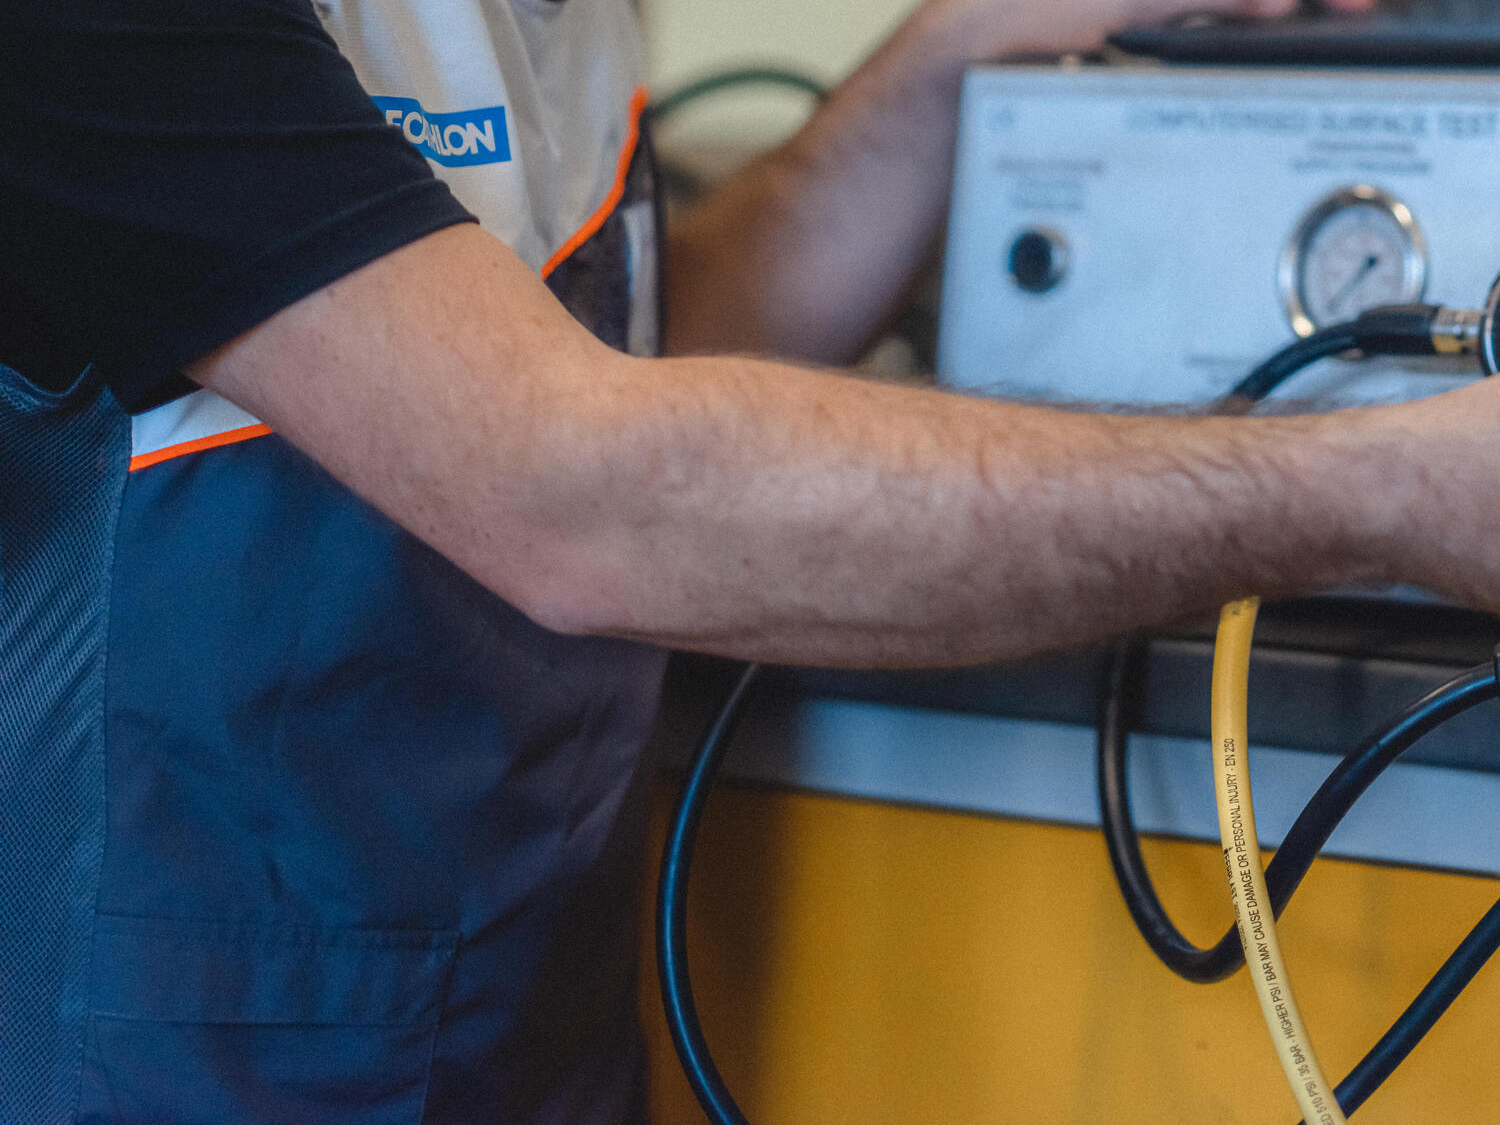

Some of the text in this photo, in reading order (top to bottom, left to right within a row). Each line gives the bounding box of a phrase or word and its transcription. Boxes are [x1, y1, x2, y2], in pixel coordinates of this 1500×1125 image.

[1317, 111, 1429, 137] SURFACE
[1437, 113, 1498, 140] TEST
[1224, 738, 1235, 753] 250
[1225, 755, 1236, 766] EN
[1226, 773, 1240, 804] INJURY
[1230, 805, 1246, 853] PERSONAL
[1237, 854, 1249, 868] OR
[1240, 869, 1258, 908] DAMAGE
[1248, 909, 1265, 940] CAUSE
[1257, 943, 1270, 961] MAY
[1263, 962, 1277, 981] BAR
[1270, 986, 1283, 1003] PSI
[1275, 1003, 1295, 1039] HIGHER
[1290, 1044, 1305, 1064] BAR
[1305, 1081, 1319, 1097] PSI
